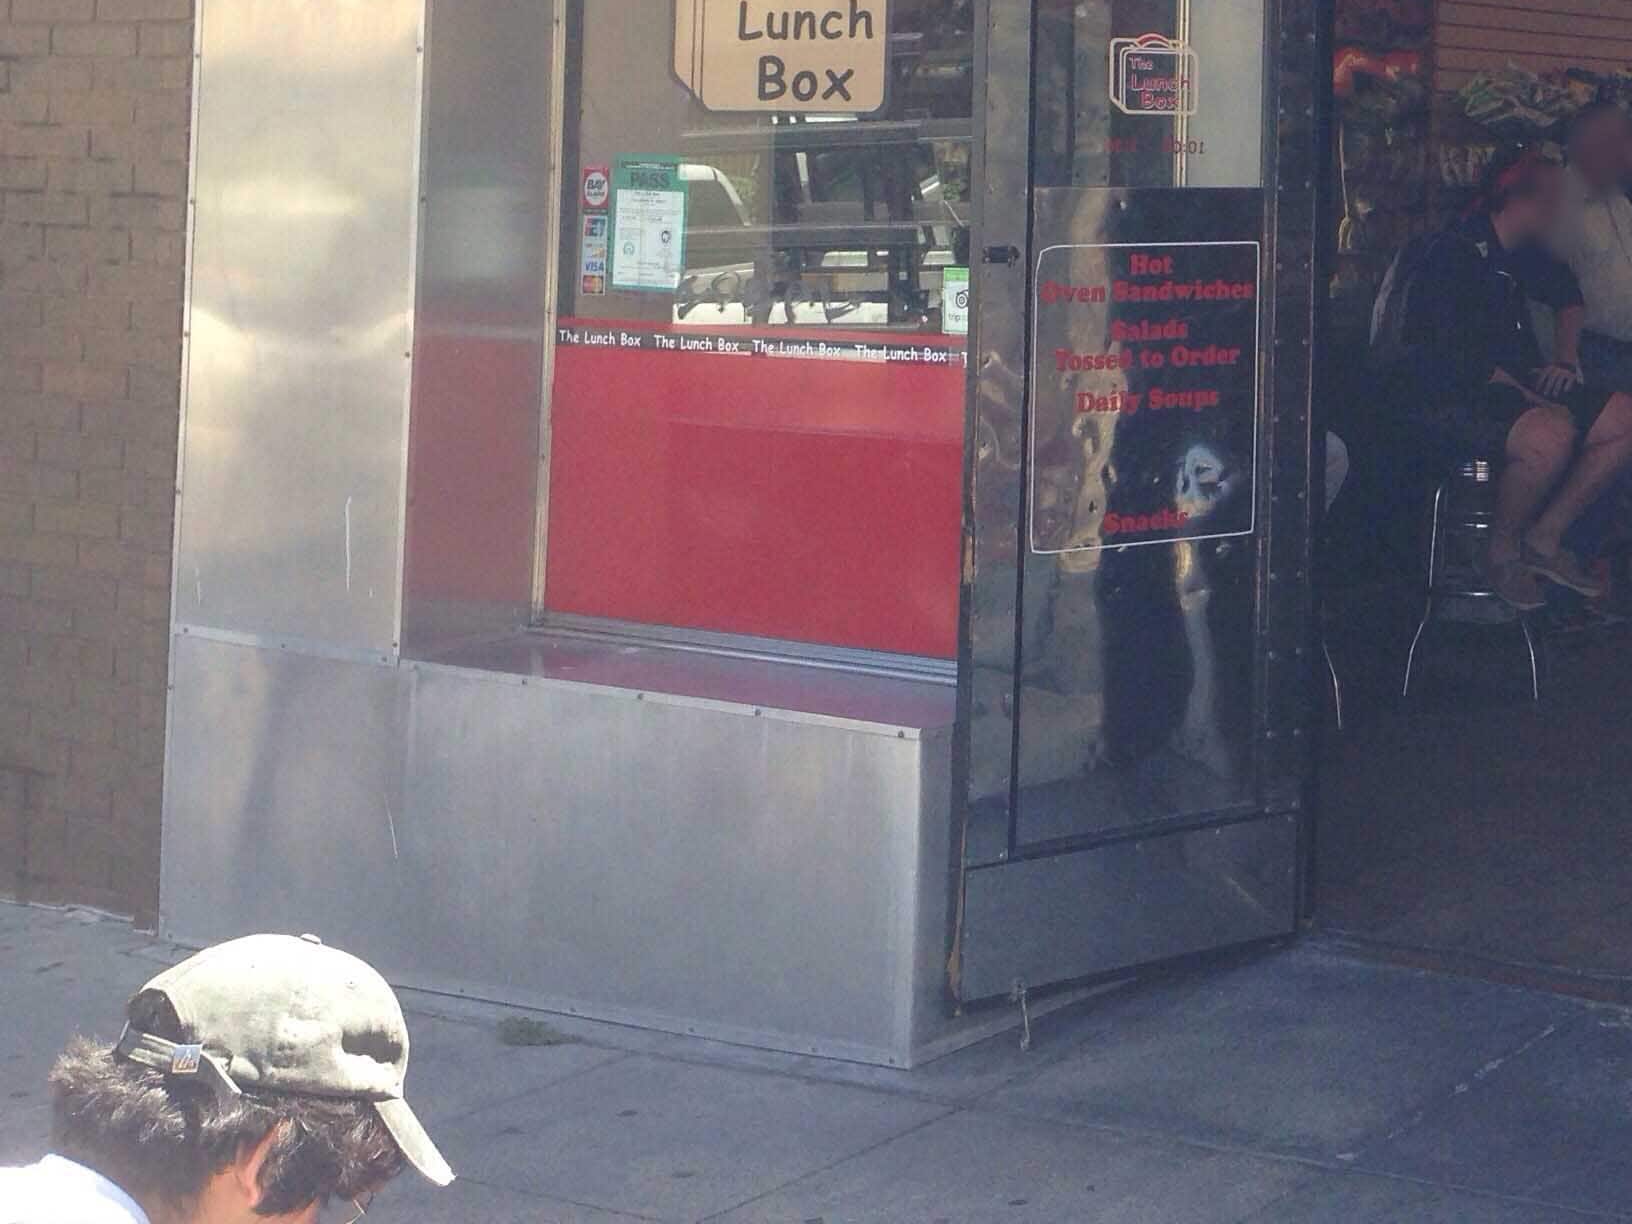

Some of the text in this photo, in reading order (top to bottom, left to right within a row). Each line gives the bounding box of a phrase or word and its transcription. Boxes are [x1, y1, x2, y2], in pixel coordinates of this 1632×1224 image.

[757, 56, 855, 101] Box
[585, 262, 604, 272] VISA
[1129, 253, 1174, 275] Hot
[1040, 279, 1256, 304] Oven Sandwiches
[1110, 319, 1189, 341] Salads
[559, 329, 580, 344] The
[584, 332, 616, 347] Lunch
[620, 333, 641, 348] Box
[653, 334, 676, 350] The
[680, 336, 712, 351] Lunch
[717, 337, 740, 353] Box
[752, 339, 775, 355] The
[779, 341, 814, 357] Lunch
[819, 342, 842, 358] Box
[855, 344, 879, 360] The
[883, 345, 919, 362] Lunch
[923, 346, 947, 364] Box
[1054, 343, 1241, 372] Tossed to Order
[1075, 386, 1219, 414] Daily Soups
[1103, 507, 1190, 534] Snacks
